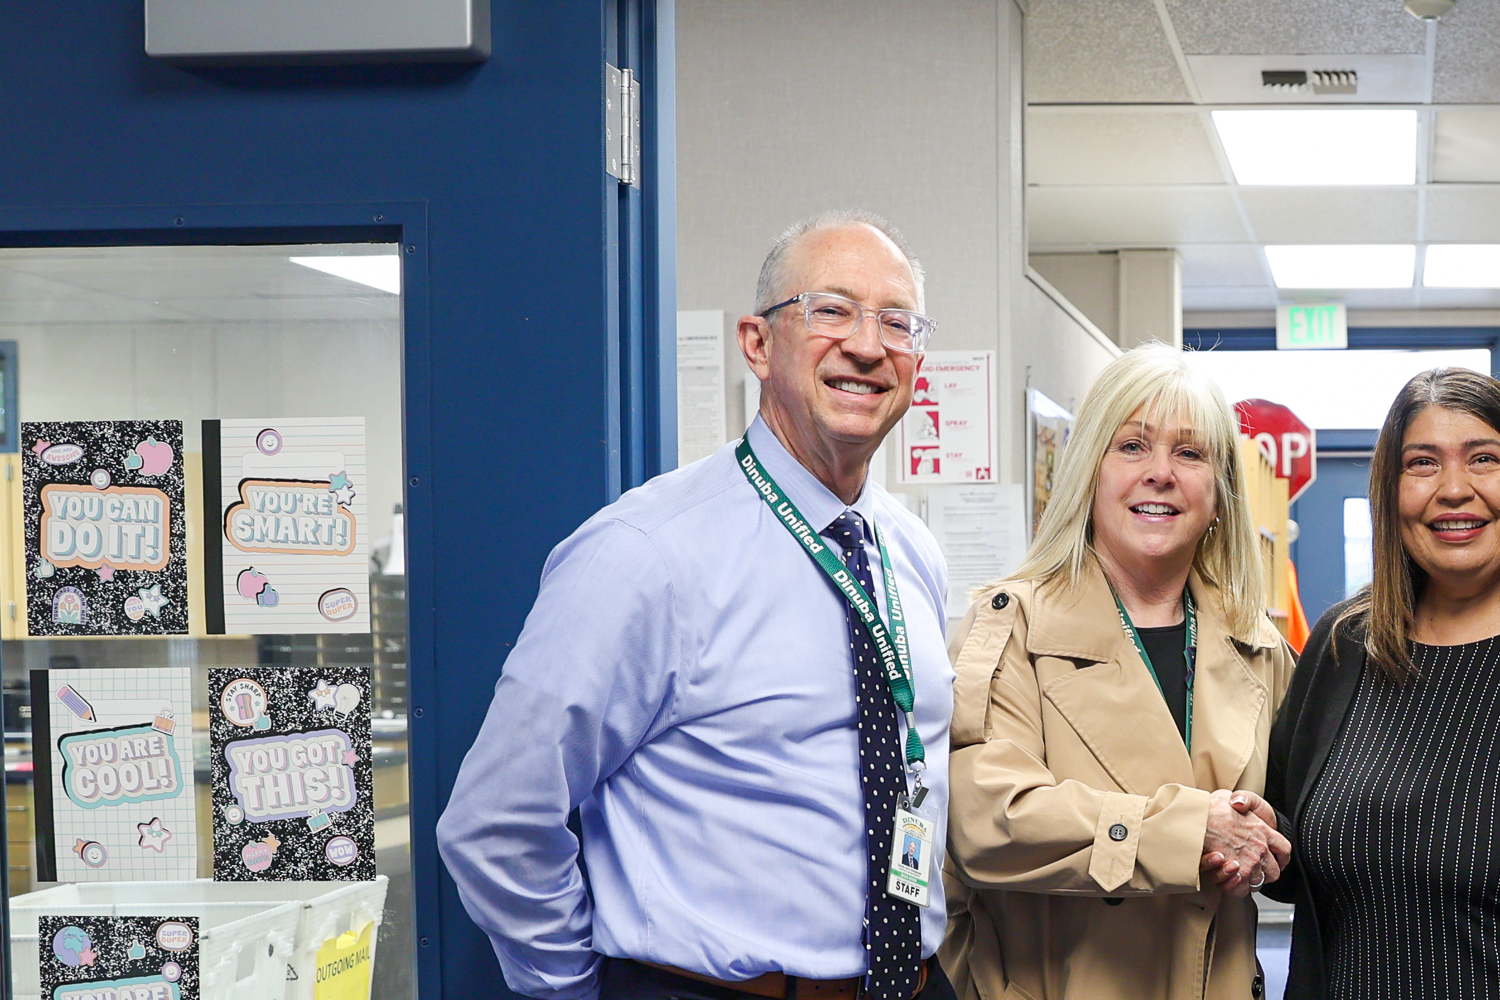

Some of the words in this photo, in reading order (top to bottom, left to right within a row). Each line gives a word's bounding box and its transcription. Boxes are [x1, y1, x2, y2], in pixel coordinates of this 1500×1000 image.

[1289, 306, 1337, 343] EXIT
[46, 450, 80, 461] AWESOME
[52, 495, 101, 520] YOU
[105, 497, 158, 522] CAN
[251, 491, 333, 515] YOU'RE
[741, 454, 779, 504] Dinuba
[777, 502, 824, 554] Unified
[51, 522, 102, 556] DO
[109, 524, 159, 560] IT!
[235, 513, 347, 545] SMART!
[127, 604, 143, 613] YOU
[324, 596, 352, 609] SUPER
[326, 602, 354, 616] DUPER
[887, 569, 902, 621] Unified
[833, 570, 875, 623] Dinuba
[872, 623, 902, 681] Unified
[226, 686, 238, 702] STAY
[240, 683, 262, 697] SHARP
[71, 742, 117, 767] YOU
[120, 737, 164, 760] ARE
[237, 747, 286, 775] YOU
[290, 741, 340, 768] GOT
[75, 759, 173, 798] COOL!
[240, 766, 346, 810] THIS!
[902, 817, 927, 833] DINUBA
[246, 849, 268, 858] HAPPY
[329, 844, 353, 858] WOW
[895, 881, 920, 898] STAFF
[316, 953, 355, 983] OUTGOING
[355, 945, 370, 967] MAIL
